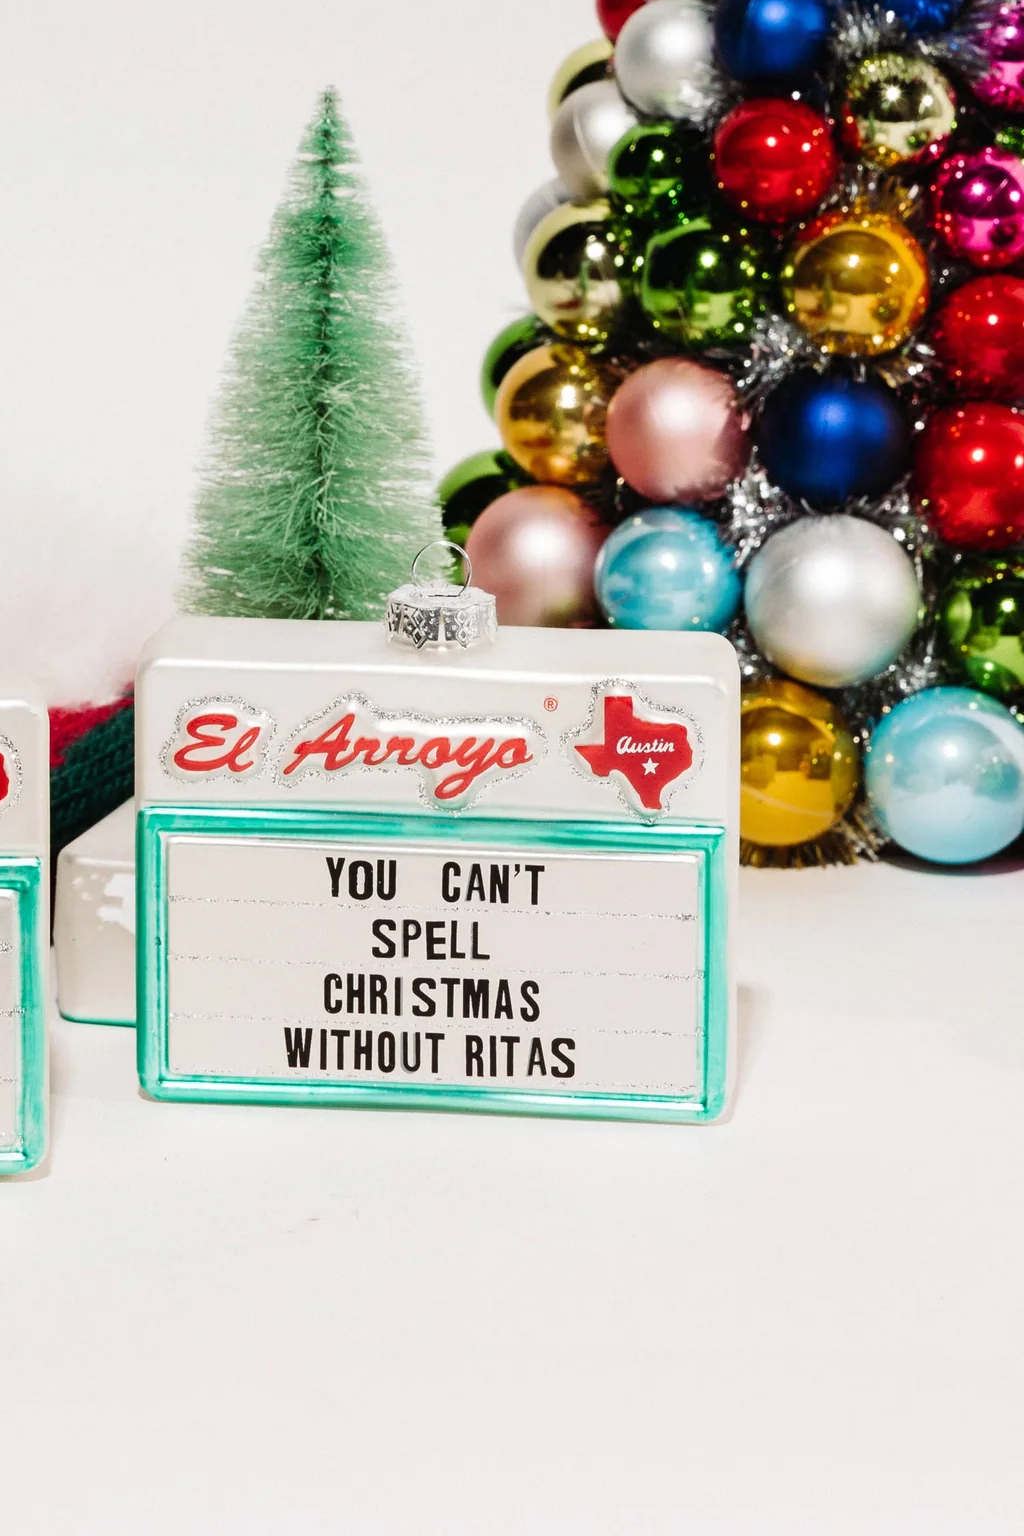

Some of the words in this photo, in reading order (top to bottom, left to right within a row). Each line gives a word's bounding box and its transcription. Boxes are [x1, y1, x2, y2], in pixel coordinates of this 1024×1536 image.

[173, 713, 261, 773] El
[283, 713, 533, 800] Arroyo
[616, 735, 675, 755] Austin
[325, 856, 397, 901] YOU
[441, 861, 545, 906] CAN'T
[371, 918, 491, 961] SPELL
[324, 973, 540, 1023] CHRISTMAS
[283, 1027, 445, 1074] WITHOUT
[465, 1034, 576, 1079] RITAS
